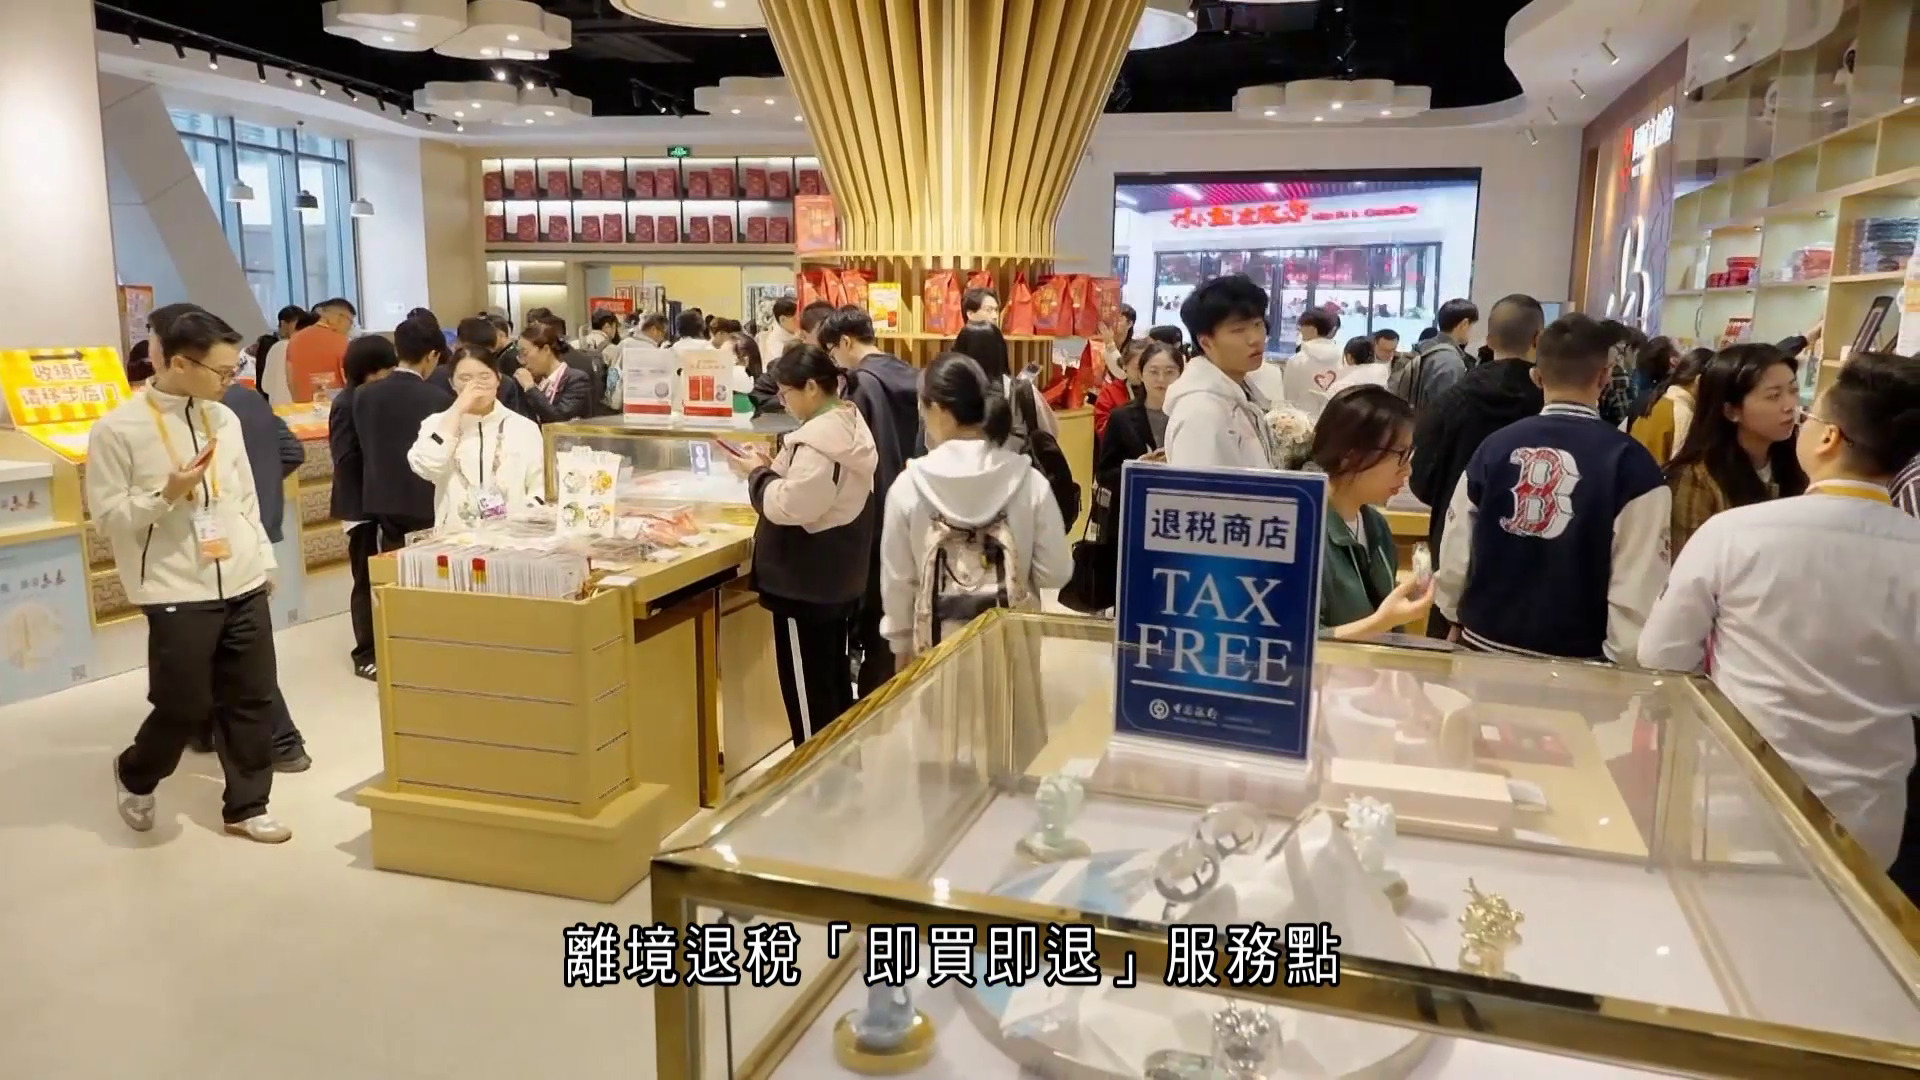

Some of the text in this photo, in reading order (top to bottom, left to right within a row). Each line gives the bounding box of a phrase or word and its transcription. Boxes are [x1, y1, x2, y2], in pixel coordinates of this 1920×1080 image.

[1499, 447, 1583, 539] B
[1151, 508, 1290, 550] 退税商店
[1152, 567, 1282, 627] TAX
[1132, 622, 1293, 687] FREE
